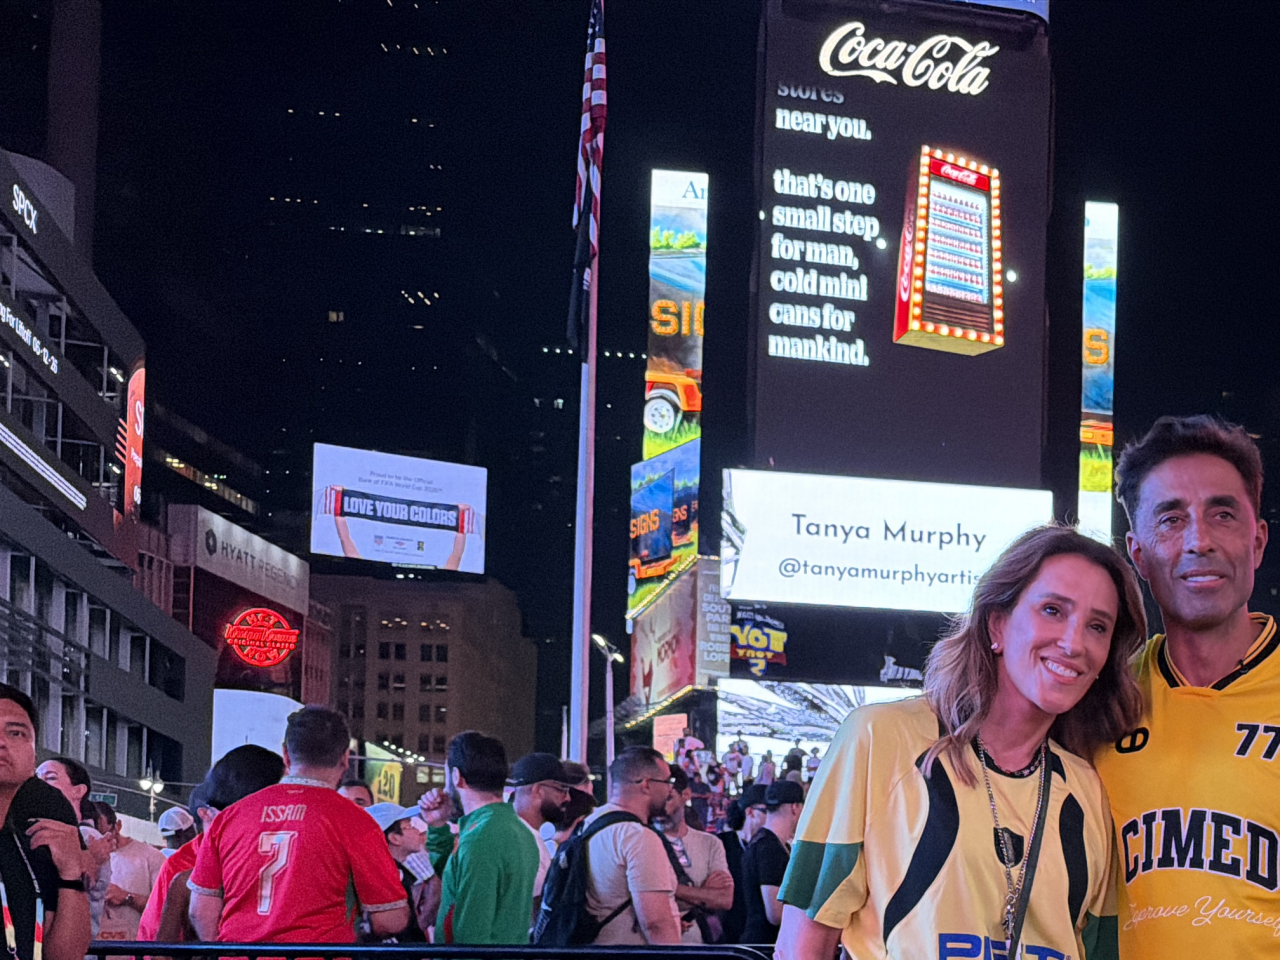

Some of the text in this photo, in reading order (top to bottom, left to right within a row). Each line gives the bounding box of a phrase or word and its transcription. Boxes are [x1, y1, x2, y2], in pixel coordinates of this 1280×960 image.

[819, 21, 1000, 95] Coca-Cola
[775, 107, 872, 140] near you.
[773, 168, 876, 205] that's one
[12, 183, 38, 235] SPCX
[772, 205, 880, 241] small step
[771, 232, 859, 270] for man,
[770, 268, 868, 301] cold mini
[769, 303, 855, 332] cans for
[768, 334, 870, 366] mankind.
[344, 496, 457, 527] LOVE YOUR COLORS
[792, 513, 987, 552] Tanya Murphy
[222, 541, 256, 571] HYATT
[778, 558, 980, 587] @tanyamurphyartis
[261, 804, 307, 823] ISSAM
[1121, 806, 1280, 892] CIMED
[257, 830, 298, 916] 7
